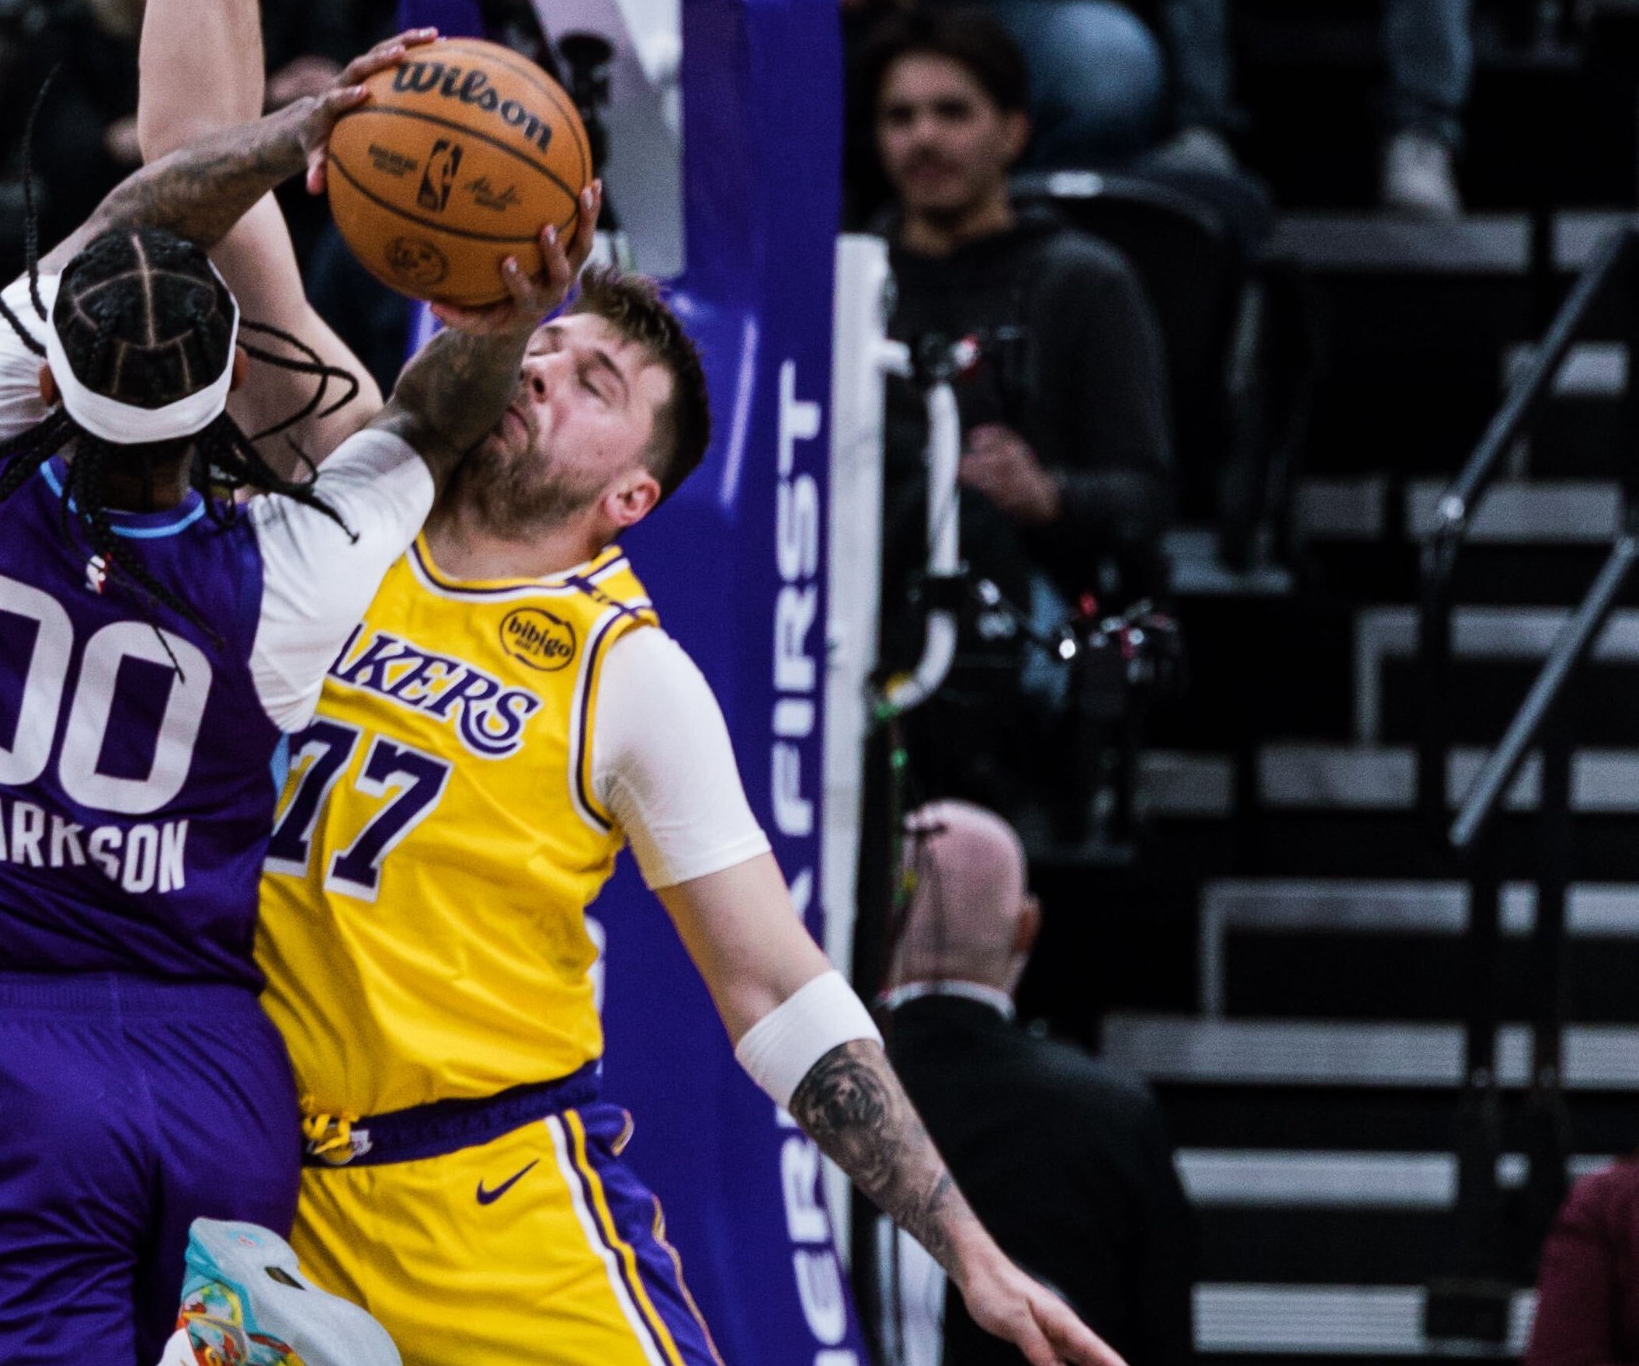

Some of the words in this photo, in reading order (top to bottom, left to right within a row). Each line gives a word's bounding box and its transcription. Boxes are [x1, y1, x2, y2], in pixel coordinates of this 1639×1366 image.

[391, 61, 554, 155] Wilson
[772, 358, 822, 836] FIRST
[326, 622, 542, 757] KERS
[262, 715, 454, 905] 77
